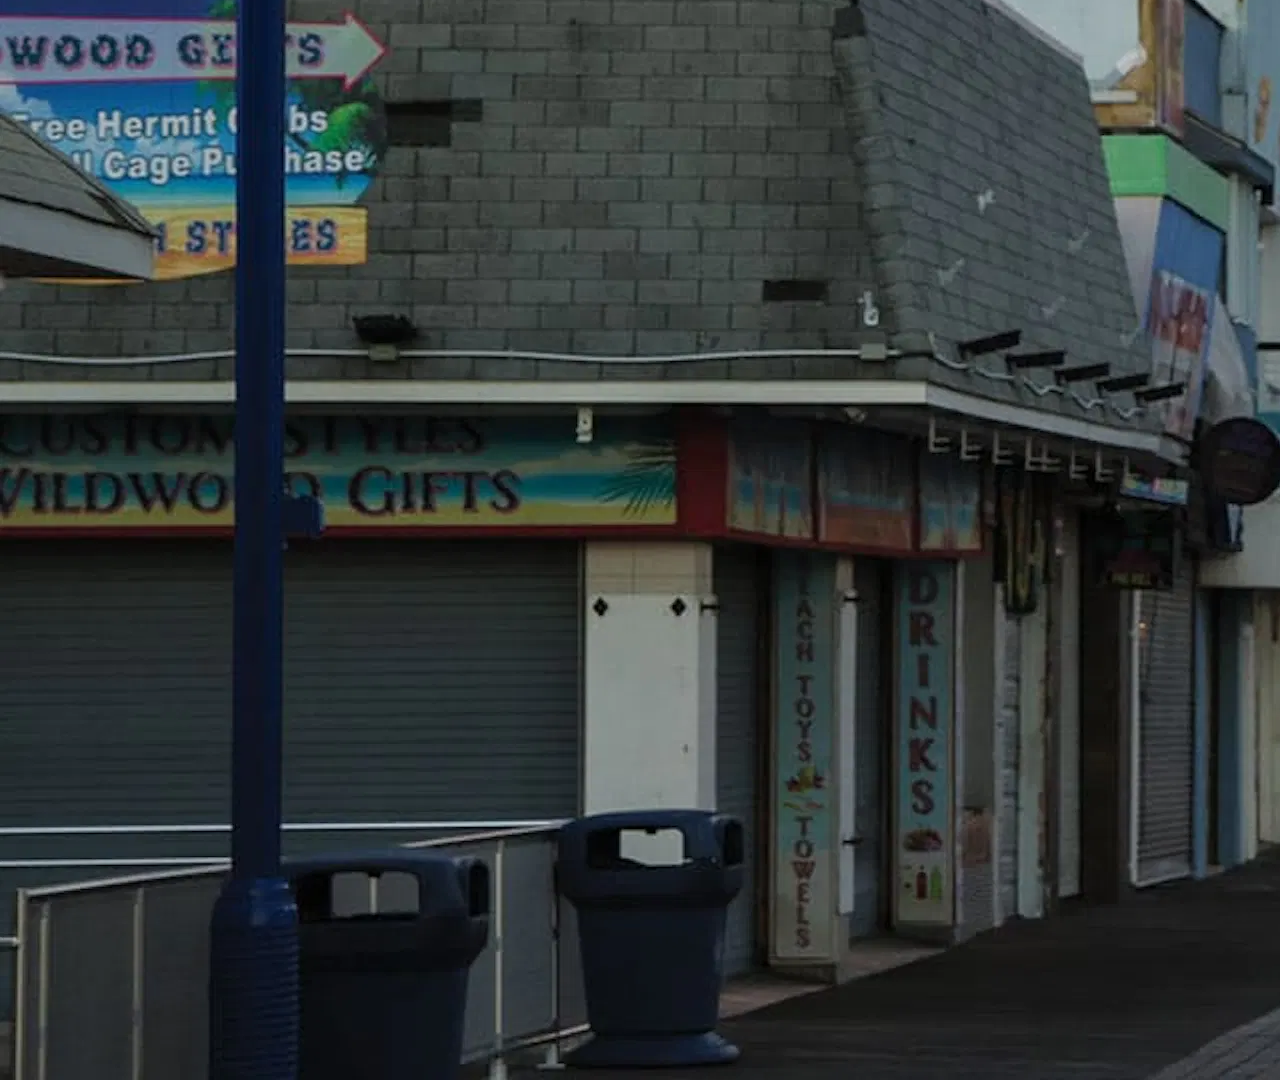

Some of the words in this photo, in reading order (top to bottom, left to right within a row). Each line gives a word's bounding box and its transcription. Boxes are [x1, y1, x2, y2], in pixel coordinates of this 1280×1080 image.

[2, 35, 155, 68] WOOD
[178, 33, 325, 68] GIS
[97, 107, 218, 139] Hermit
[104, 149, 191, 186] Cage
[187, 220, 337, 252] STES
[348, 465, 523, 517] GIFTS
[908, 572, 939, 815] DRINKS
